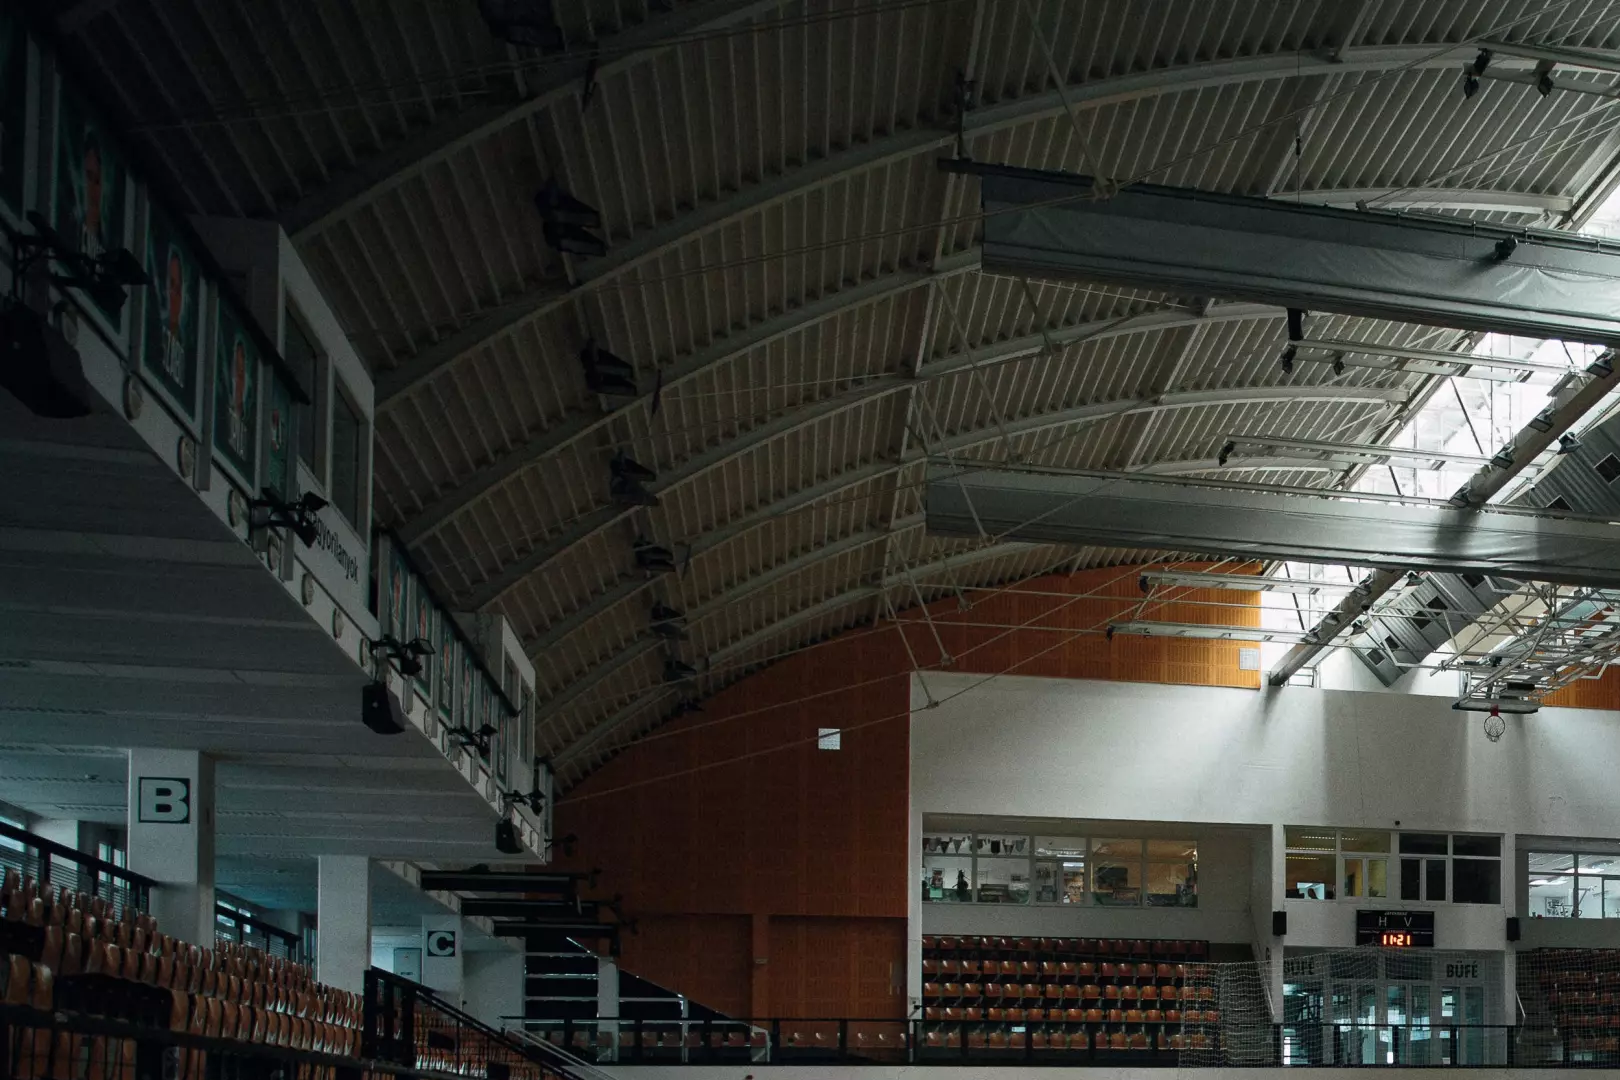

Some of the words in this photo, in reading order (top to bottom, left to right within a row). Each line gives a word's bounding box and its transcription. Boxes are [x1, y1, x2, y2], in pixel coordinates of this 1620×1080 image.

[140, 778, 189, 822] B
[1379, 916, 1387, 926] H
[1404, 917, 1412, 927] V
[428, 931, 455, 956] C
[1446, 960, 1478, 978] BÜFÉ
